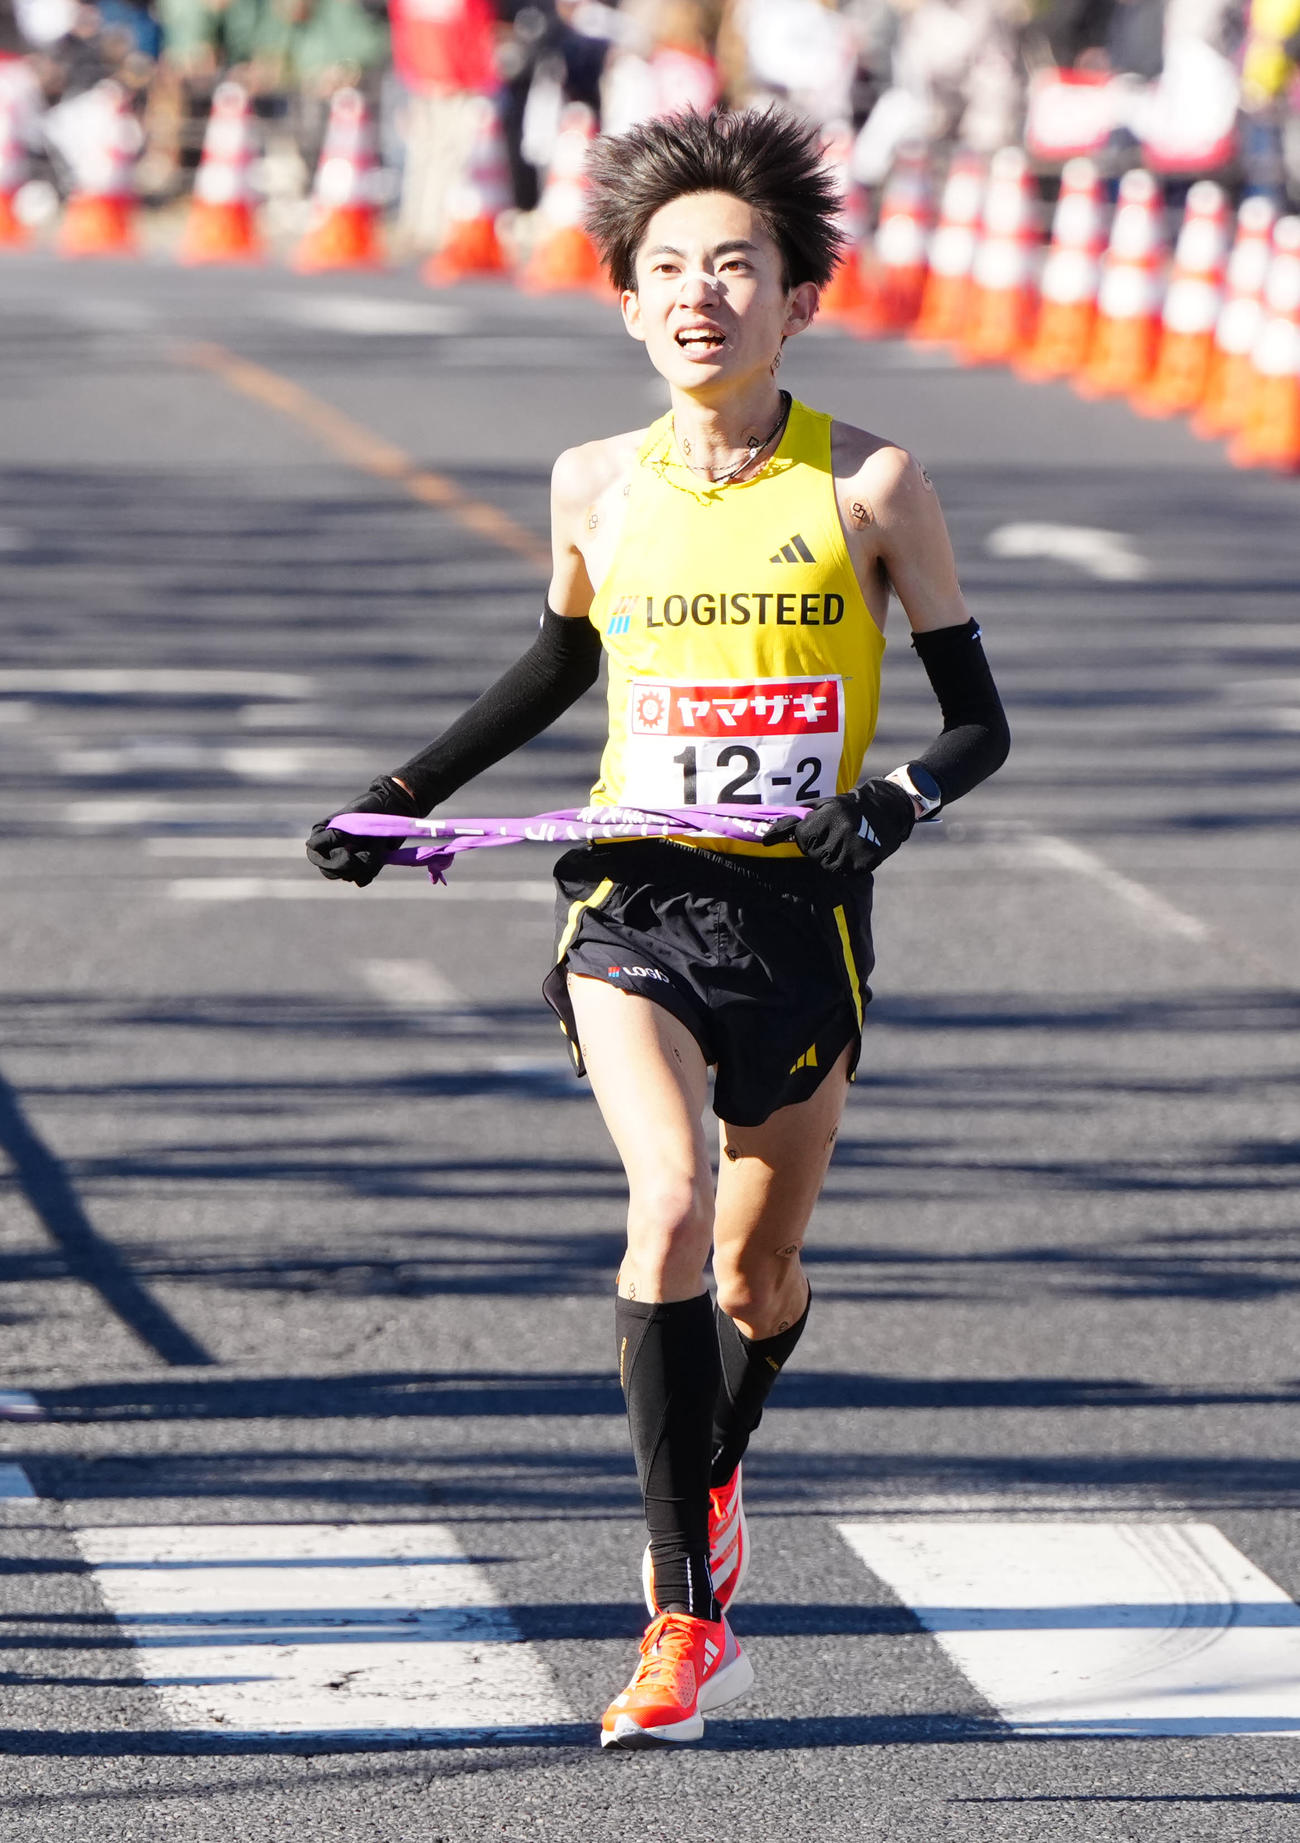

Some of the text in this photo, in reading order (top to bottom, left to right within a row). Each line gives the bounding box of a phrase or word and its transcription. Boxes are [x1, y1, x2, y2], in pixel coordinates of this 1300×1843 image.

[646, 592, 845, 628] LOGISTEED
[677, 694, 828, 727] ヤマザキ
